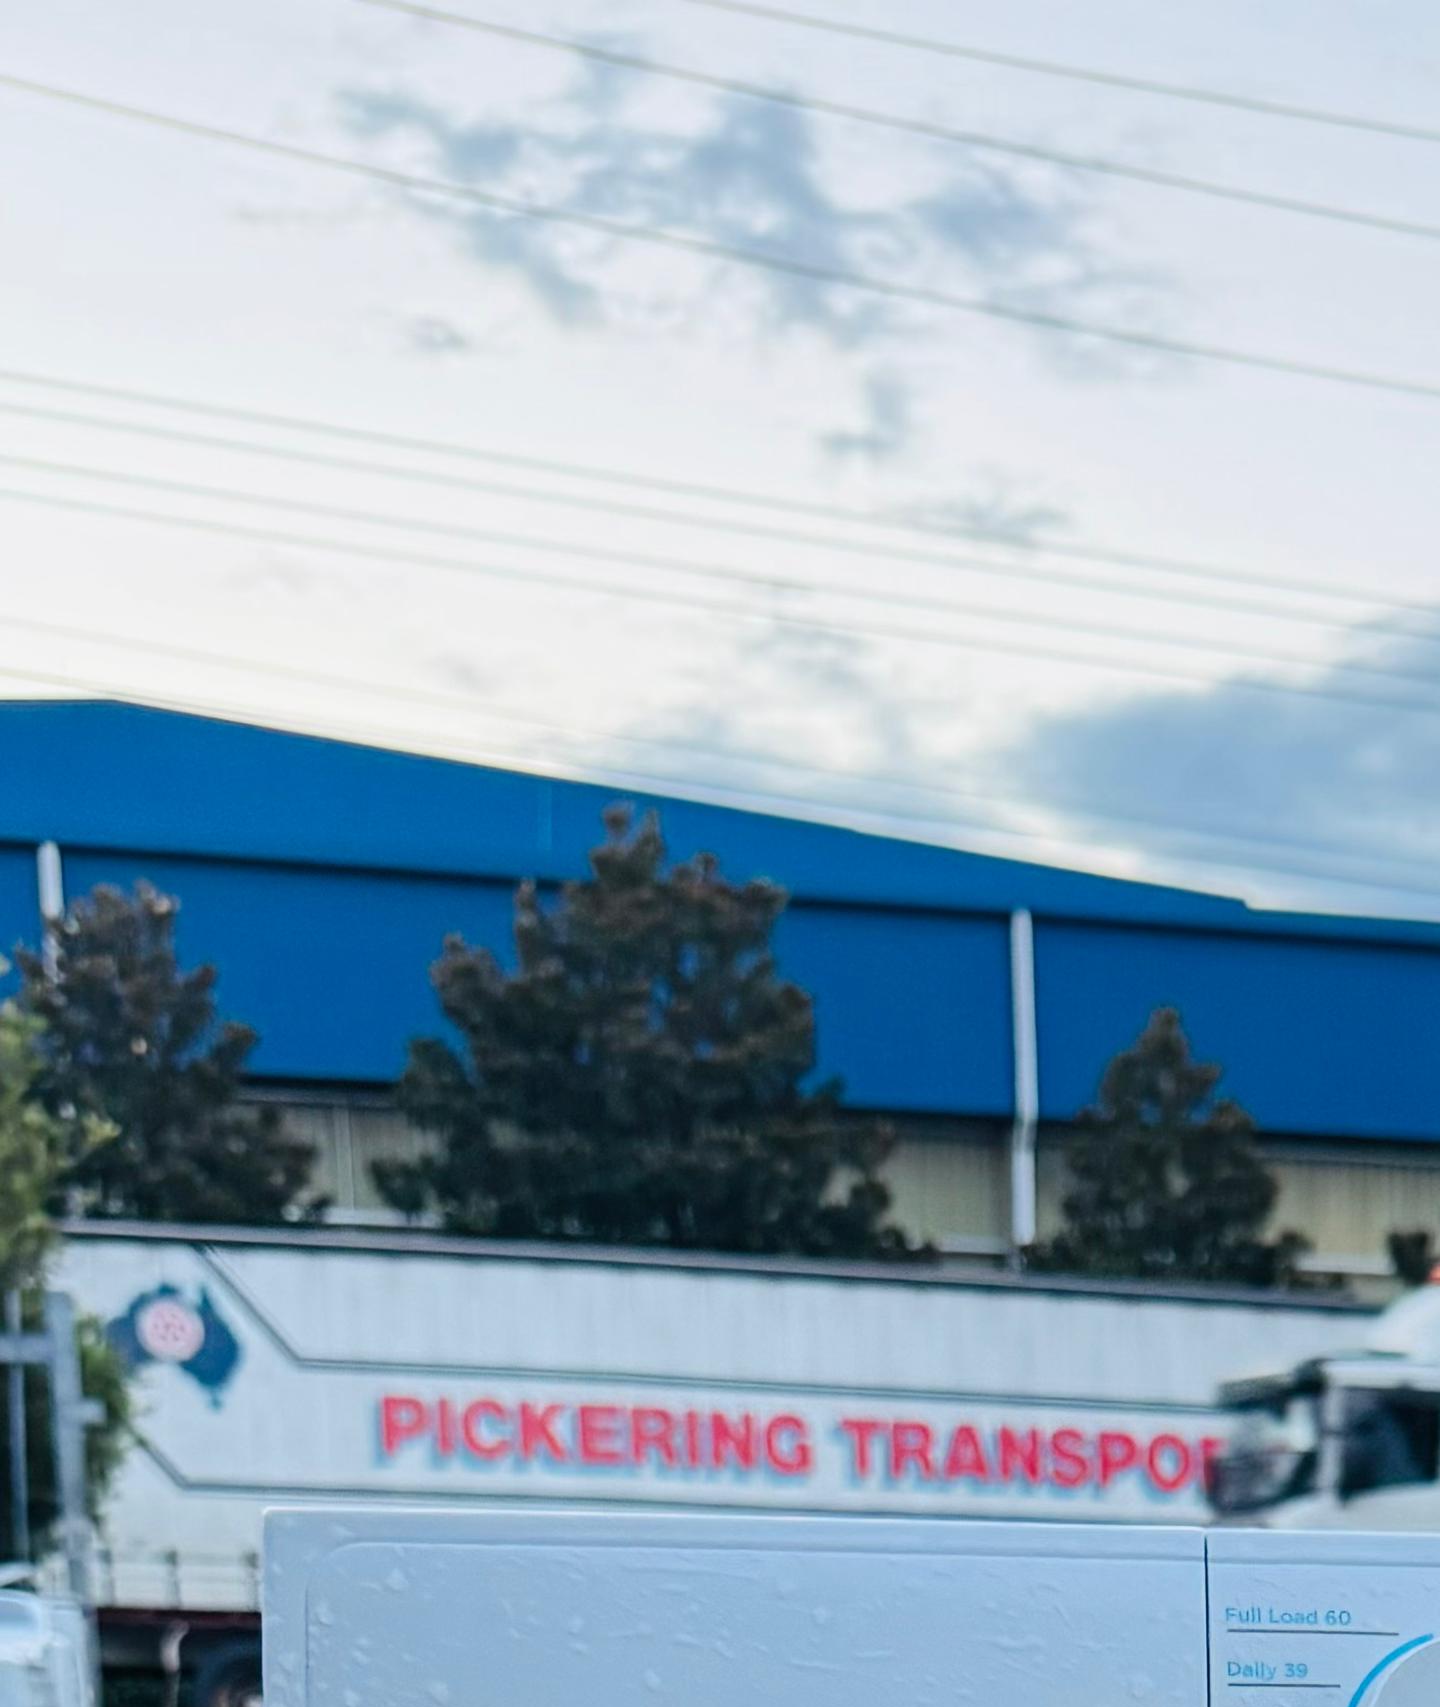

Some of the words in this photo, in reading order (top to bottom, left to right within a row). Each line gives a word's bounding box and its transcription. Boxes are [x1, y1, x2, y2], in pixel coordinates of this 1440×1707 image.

[379, 1393, 817, 1477] PICKERING
[840, 1417, 1229, 1494] TRANSPO
[1225, 1607, 1262, 1623] Full
[1268, 1608, 1318, 1625] Load
[1324, 1610, 1352, 1626] 60
[1226, 1660, 1277, 1681] Daily
[1284, 1662, 1309, 1678] 39
